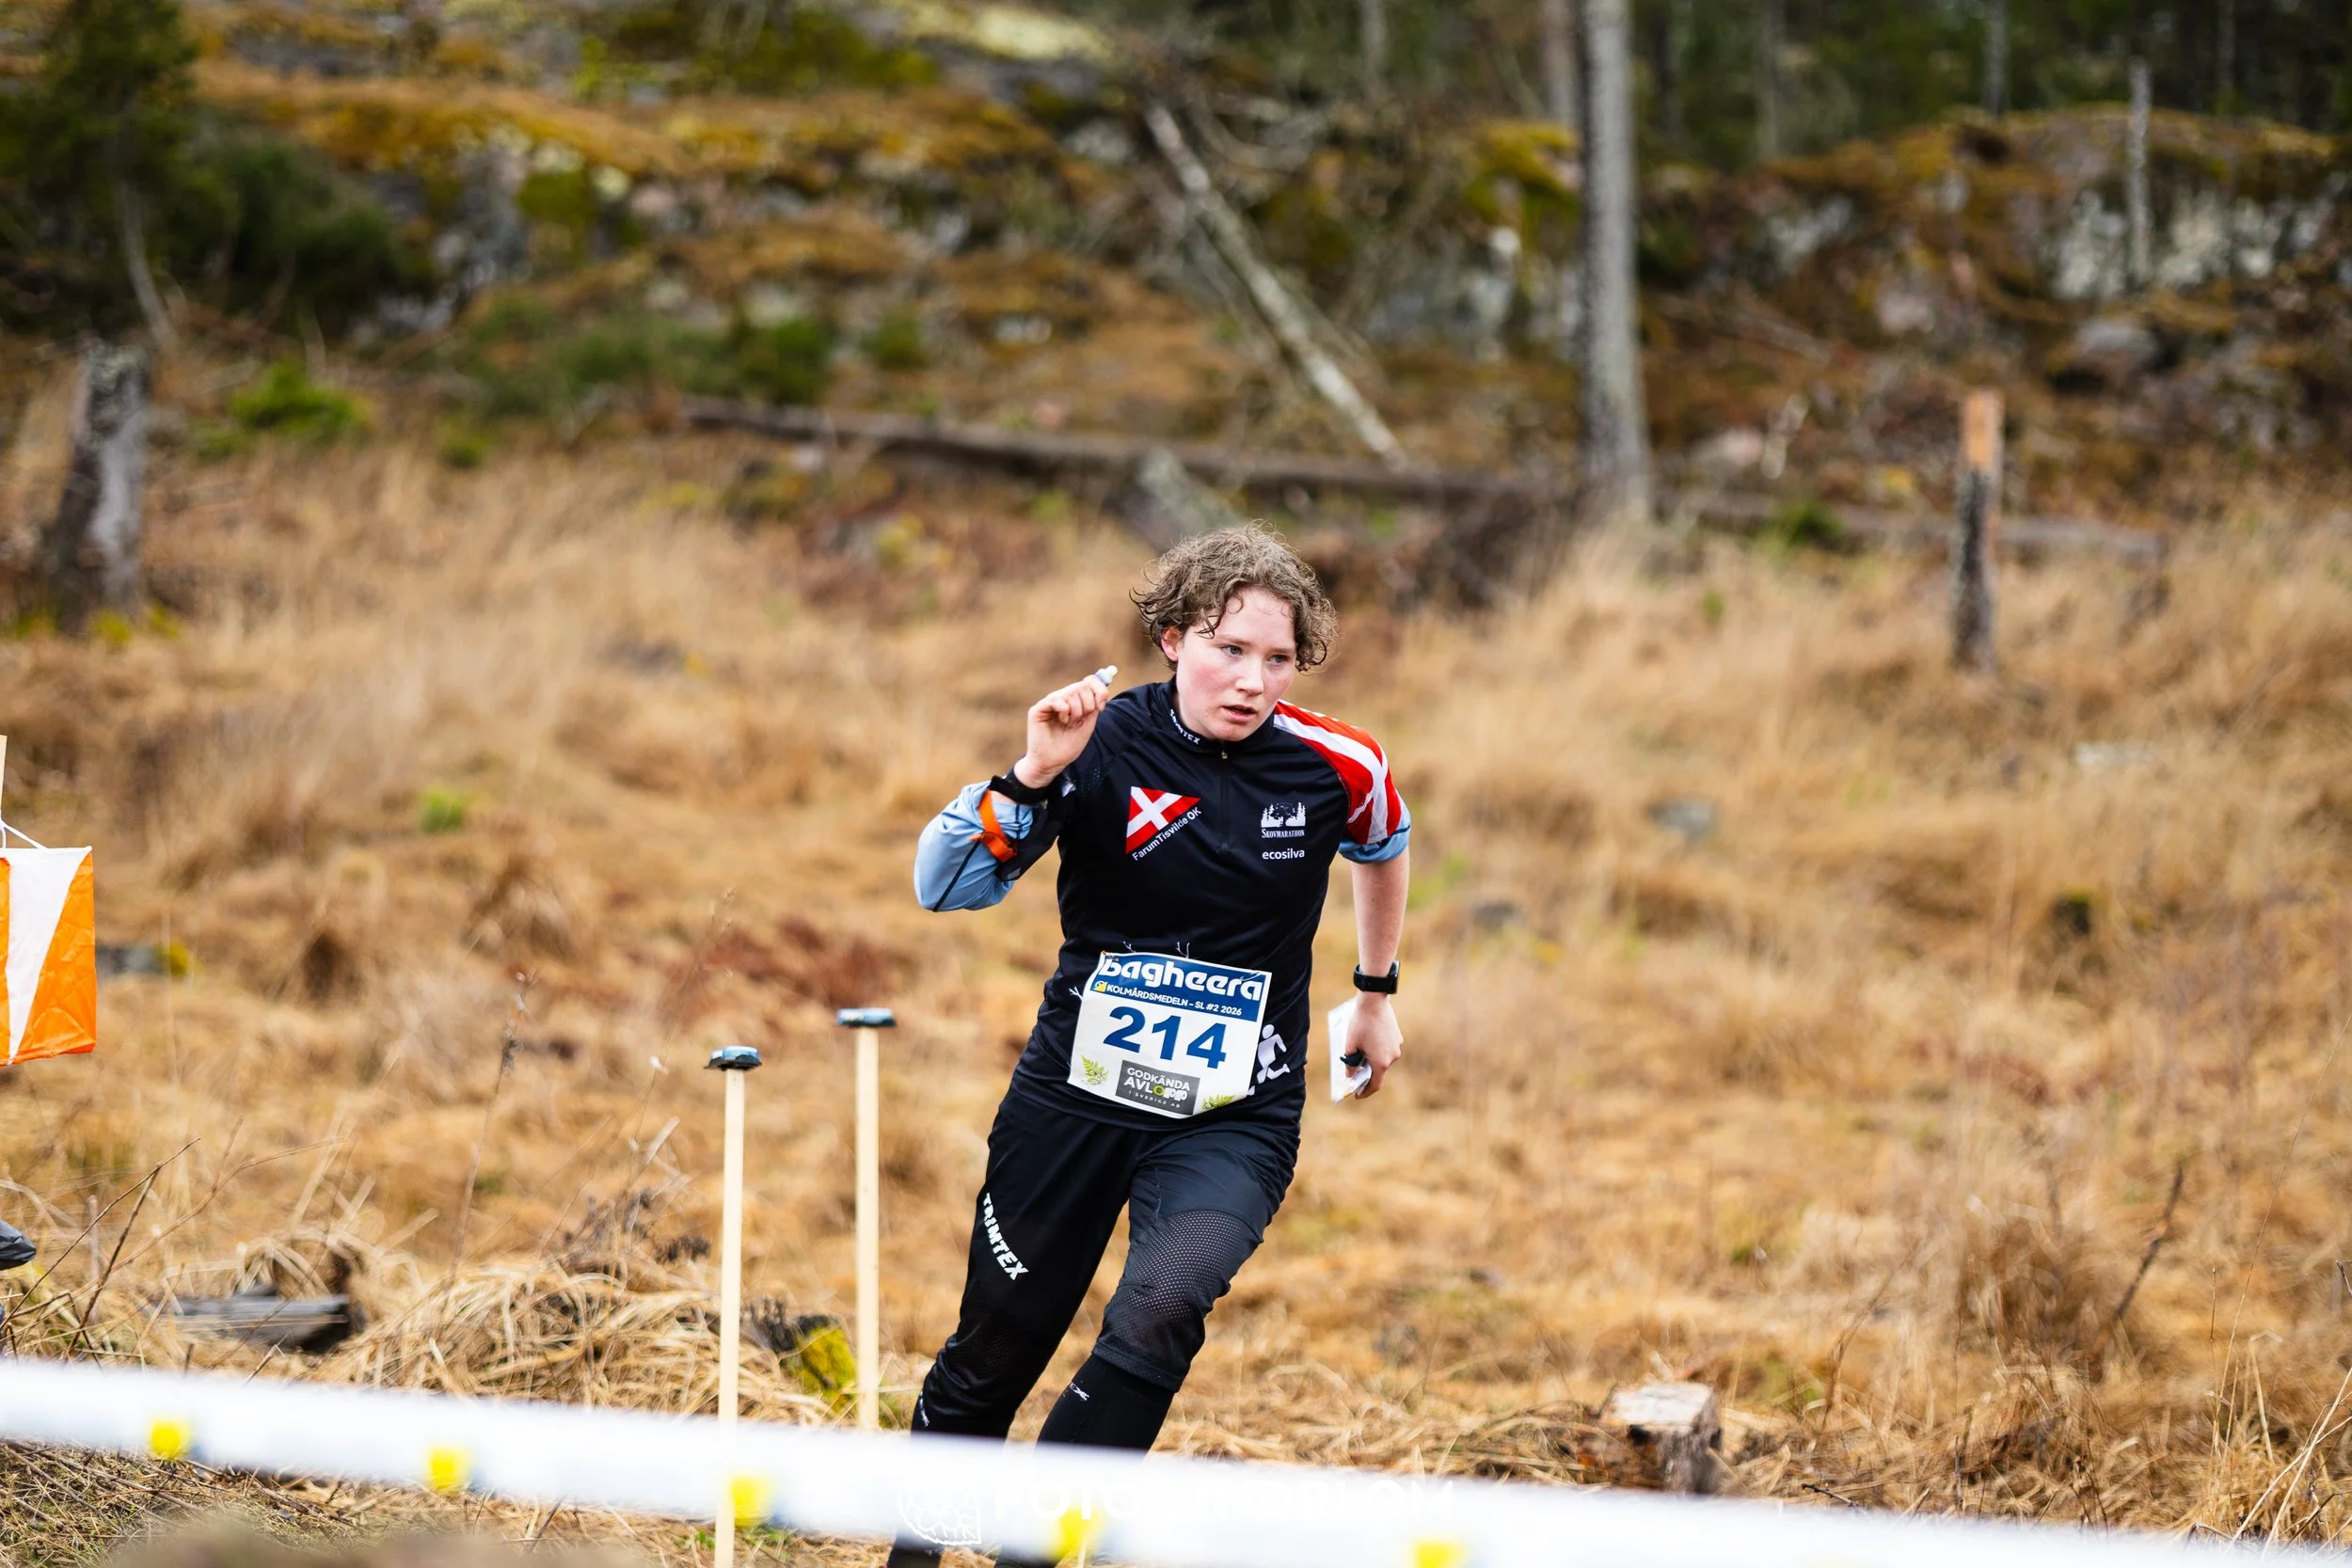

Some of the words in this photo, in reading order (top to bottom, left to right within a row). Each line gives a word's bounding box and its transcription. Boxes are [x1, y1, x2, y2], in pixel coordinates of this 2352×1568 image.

[1132, 816, 1188, 862] FarumTisvilde
[1187, 806, 1202, 821] OK
[1262, 847, 1305, 860] ecosilva
[1098, 958, 1263, 1002] bagheera
[1106, 983, 1188, 1006] KOLMÅRDSMEDELN
[1195, 1001, 1205, 1009] SL
[1206, 1003, 1219, 1012] #2
[1220, 1006, 1242, 1016] 2026
[1103, 1006, 1227, 1069] 214
[1127, 1067, 1190, 1091] GODKÄNDA
[1135, 1092, 1167, 1105] SVERIGE
[983, 1193, 1029, 1281] TRIMTEX
